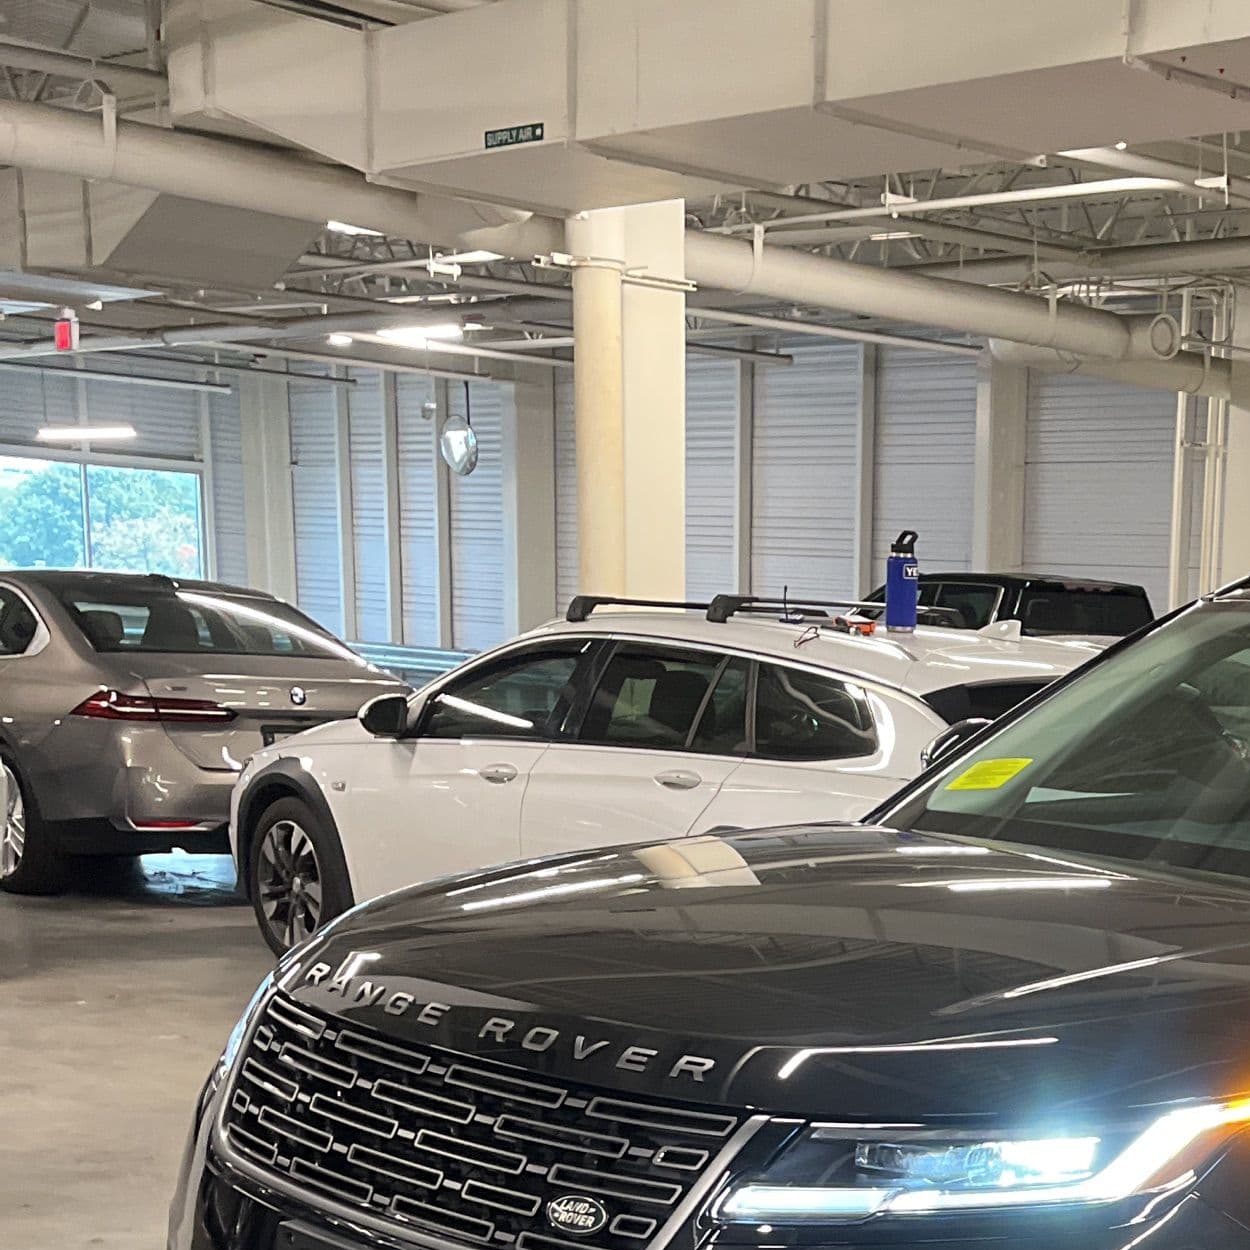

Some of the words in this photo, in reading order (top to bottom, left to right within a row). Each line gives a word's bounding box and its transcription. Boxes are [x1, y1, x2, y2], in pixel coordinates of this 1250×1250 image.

[486, 128, 517, 146] SUPPLY
[518, 127, 533, 142] AIR
[304, 961, 451, 1026] RANGE
[477, 1016, 716, 1083] ROVER
